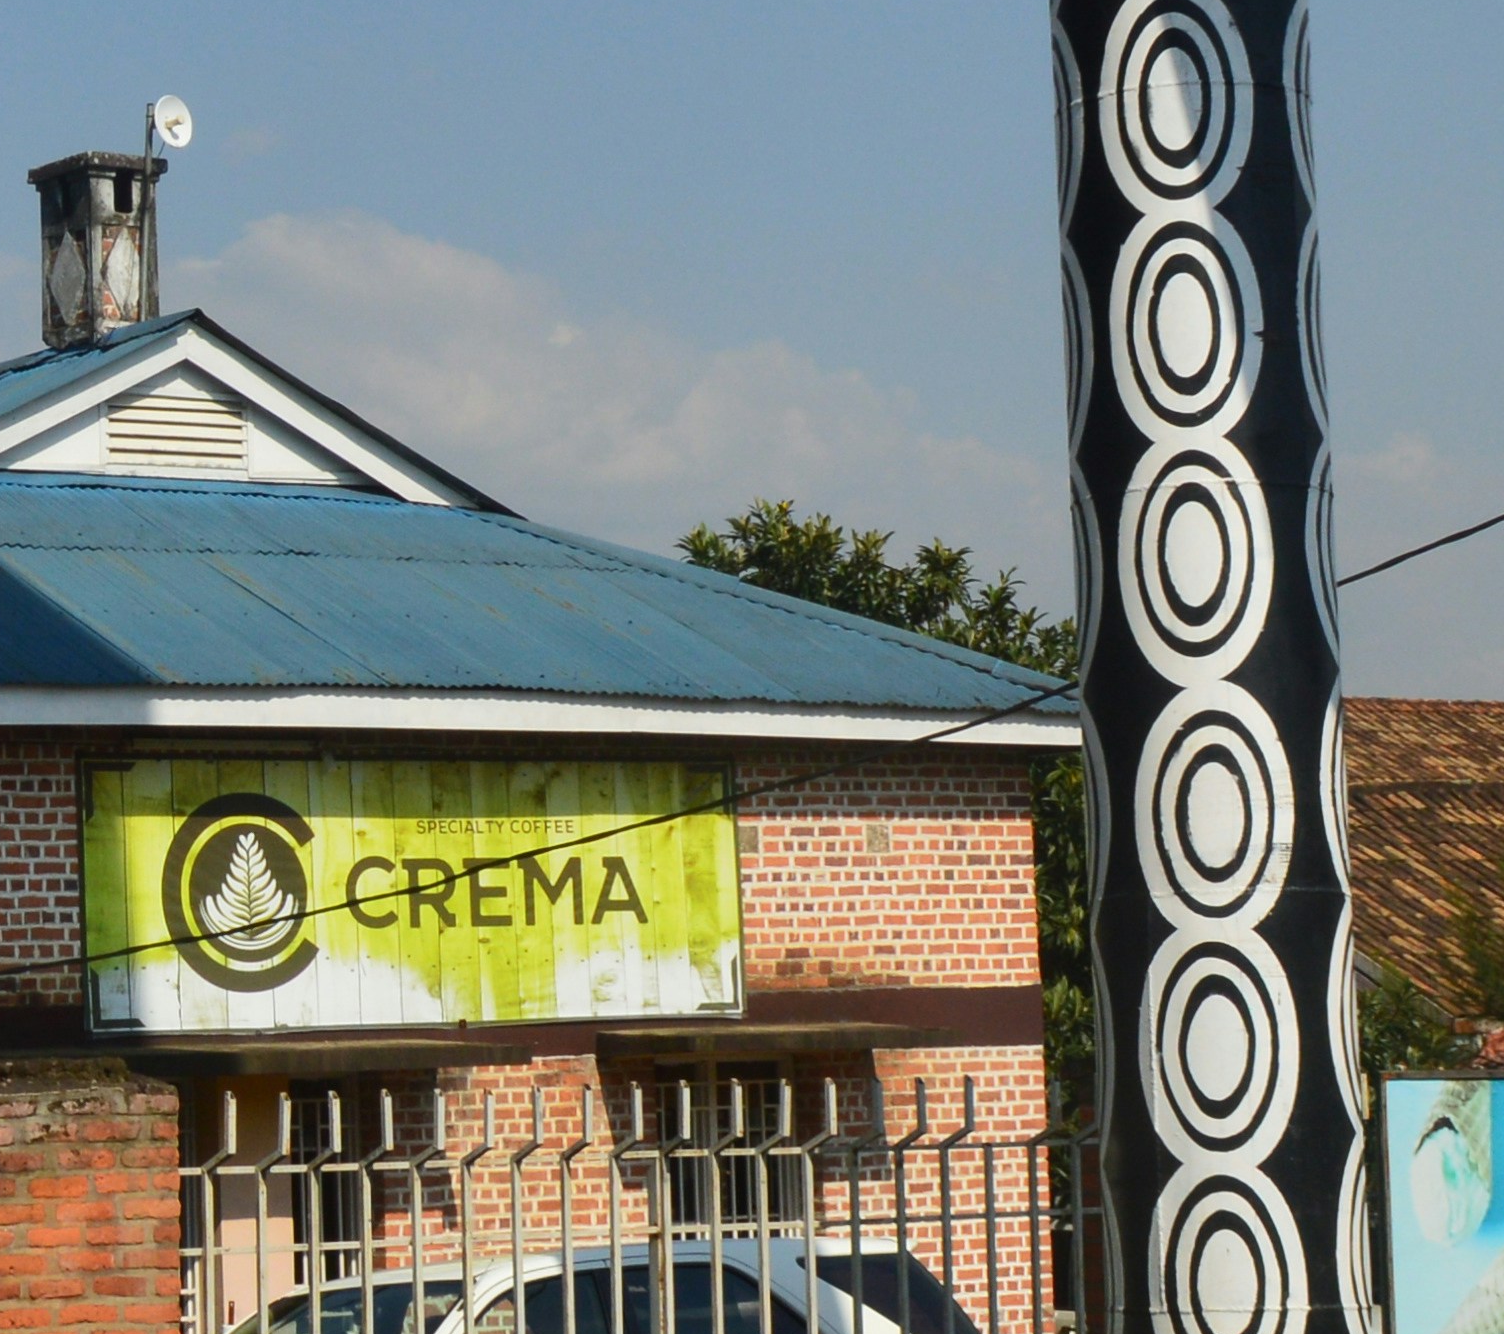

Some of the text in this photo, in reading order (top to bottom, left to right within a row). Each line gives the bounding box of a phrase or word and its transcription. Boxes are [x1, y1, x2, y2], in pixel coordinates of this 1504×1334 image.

[416, 818, 574, 835] SPECIALTY COFFEE
[345, 855, 648, 929] CREMA
